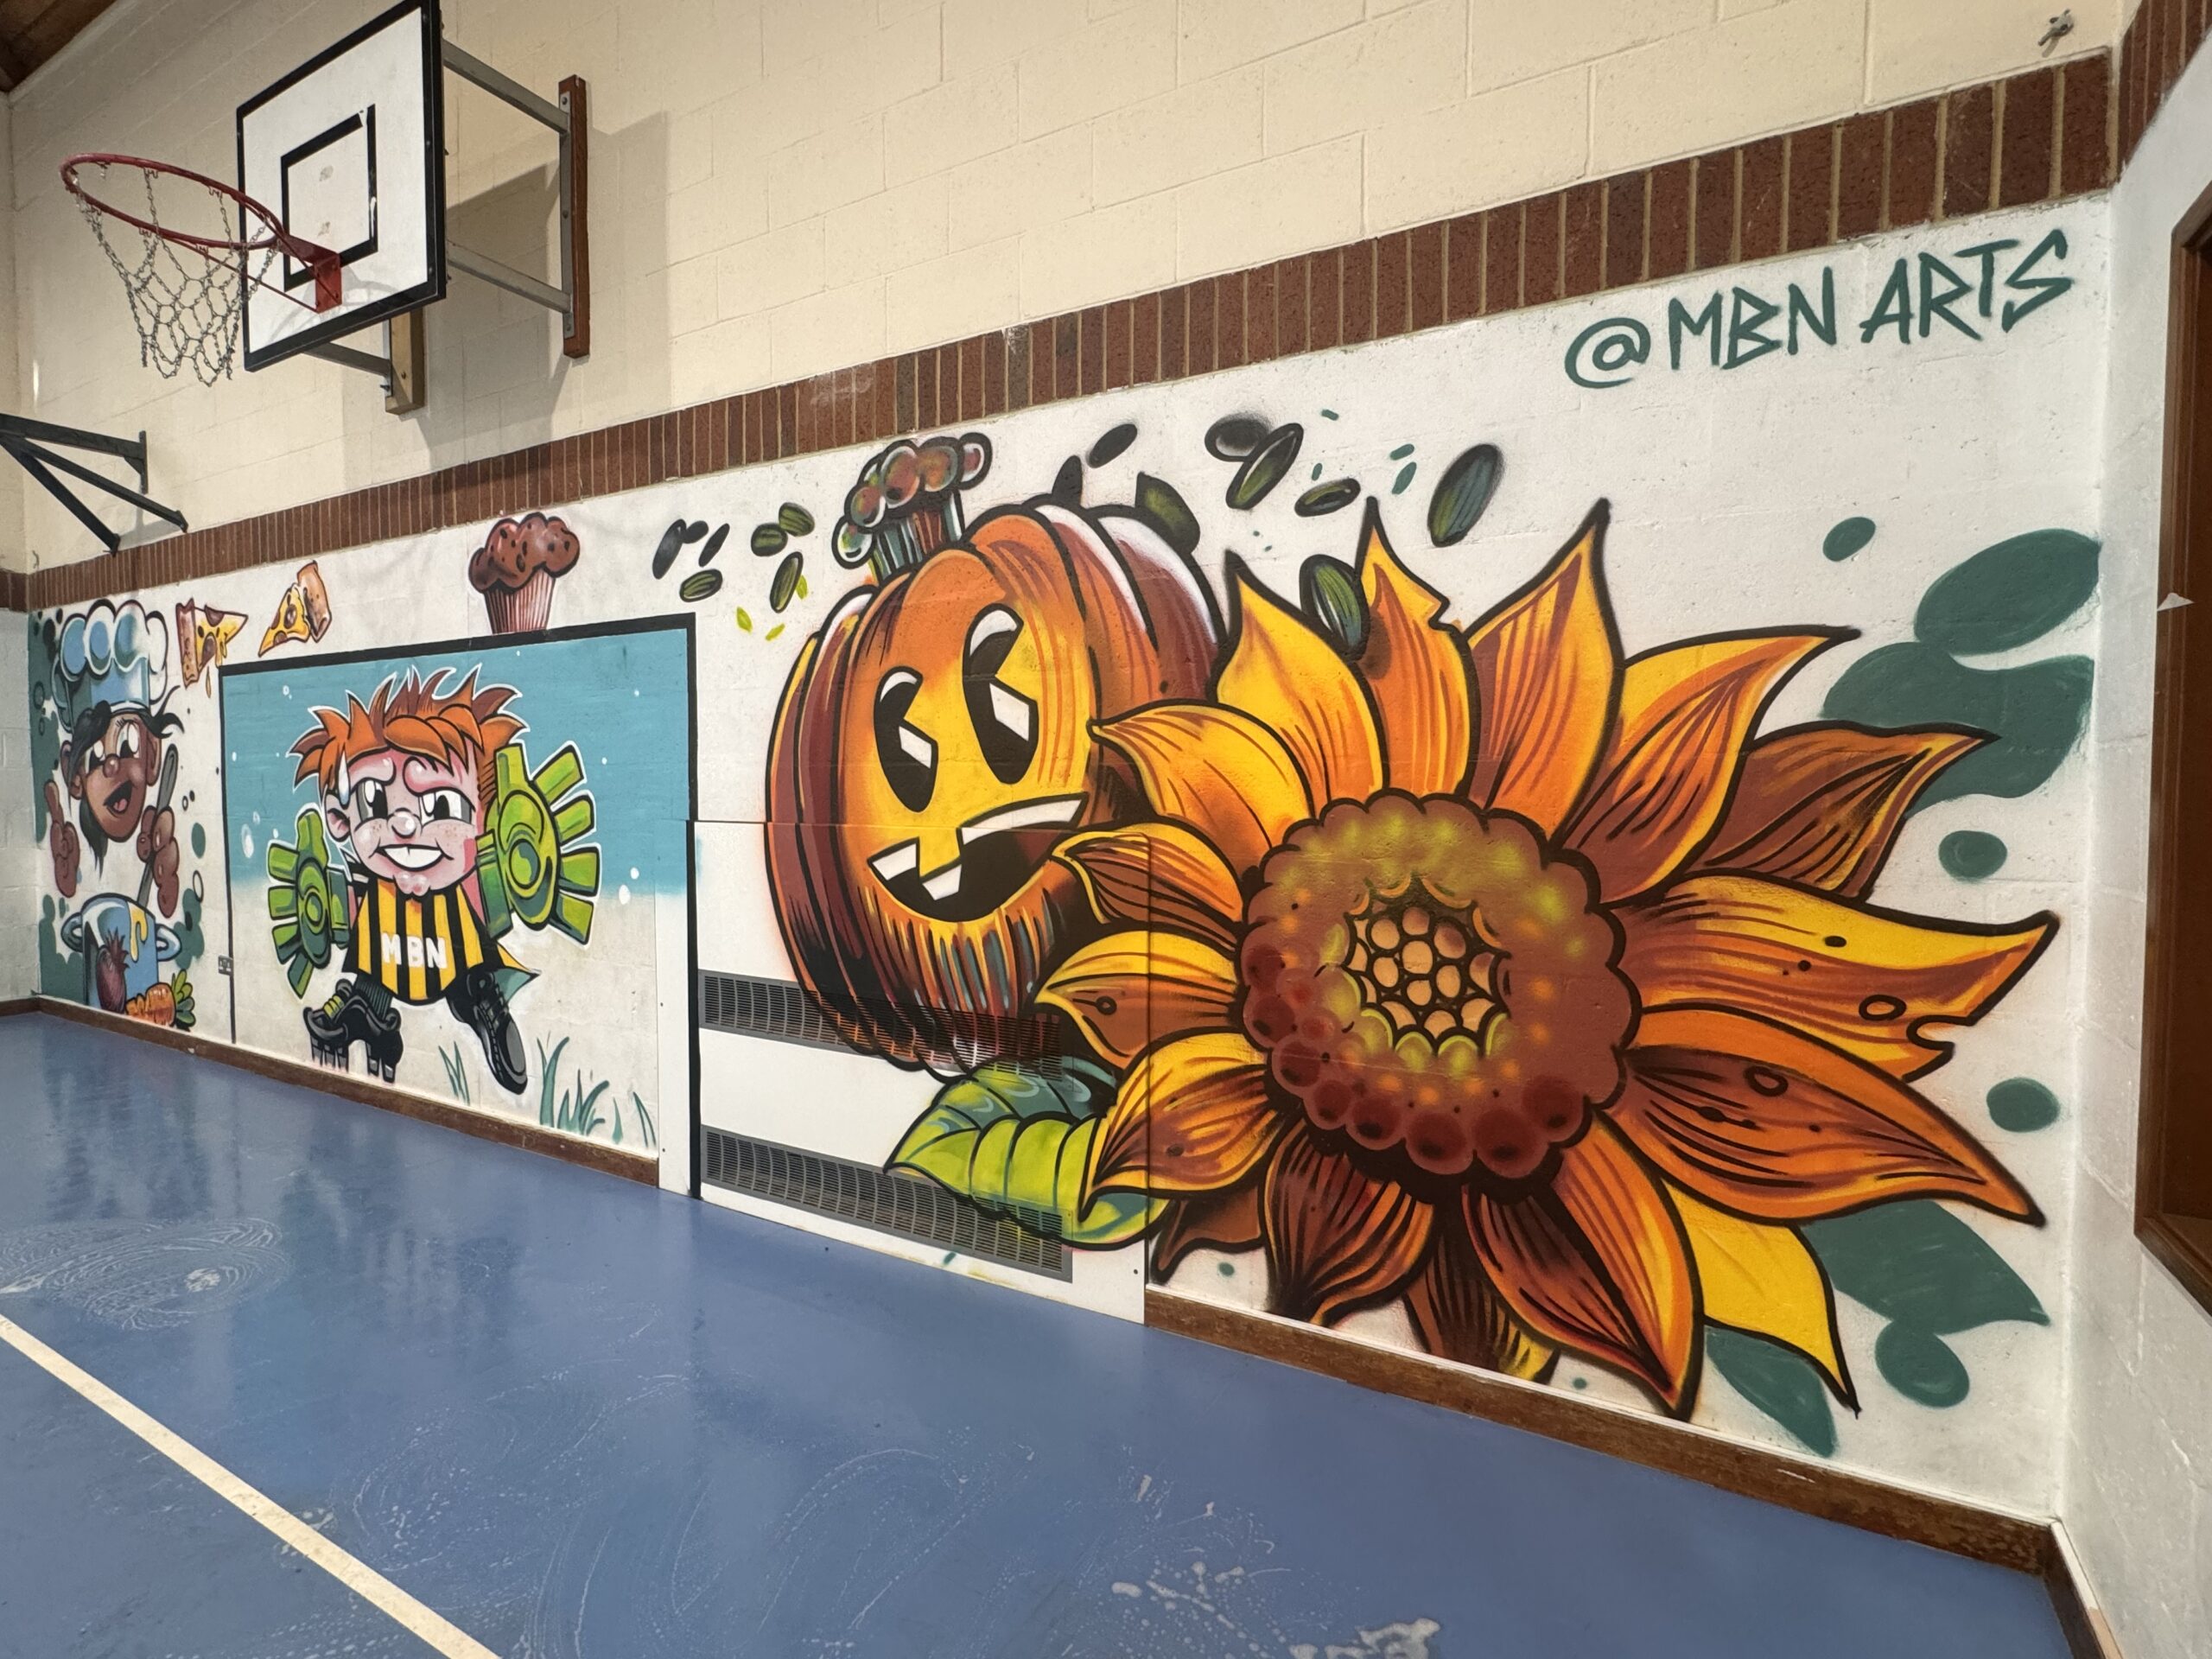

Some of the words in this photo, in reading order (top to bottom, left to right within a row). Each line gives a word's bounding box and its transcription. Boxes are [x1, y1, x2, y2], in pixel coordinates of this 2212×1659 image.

[1565, 266, 1836, 389] @MBN
[1859, 228, 2075, 344] ARTS
[381, 932, 448, 969] MBN
